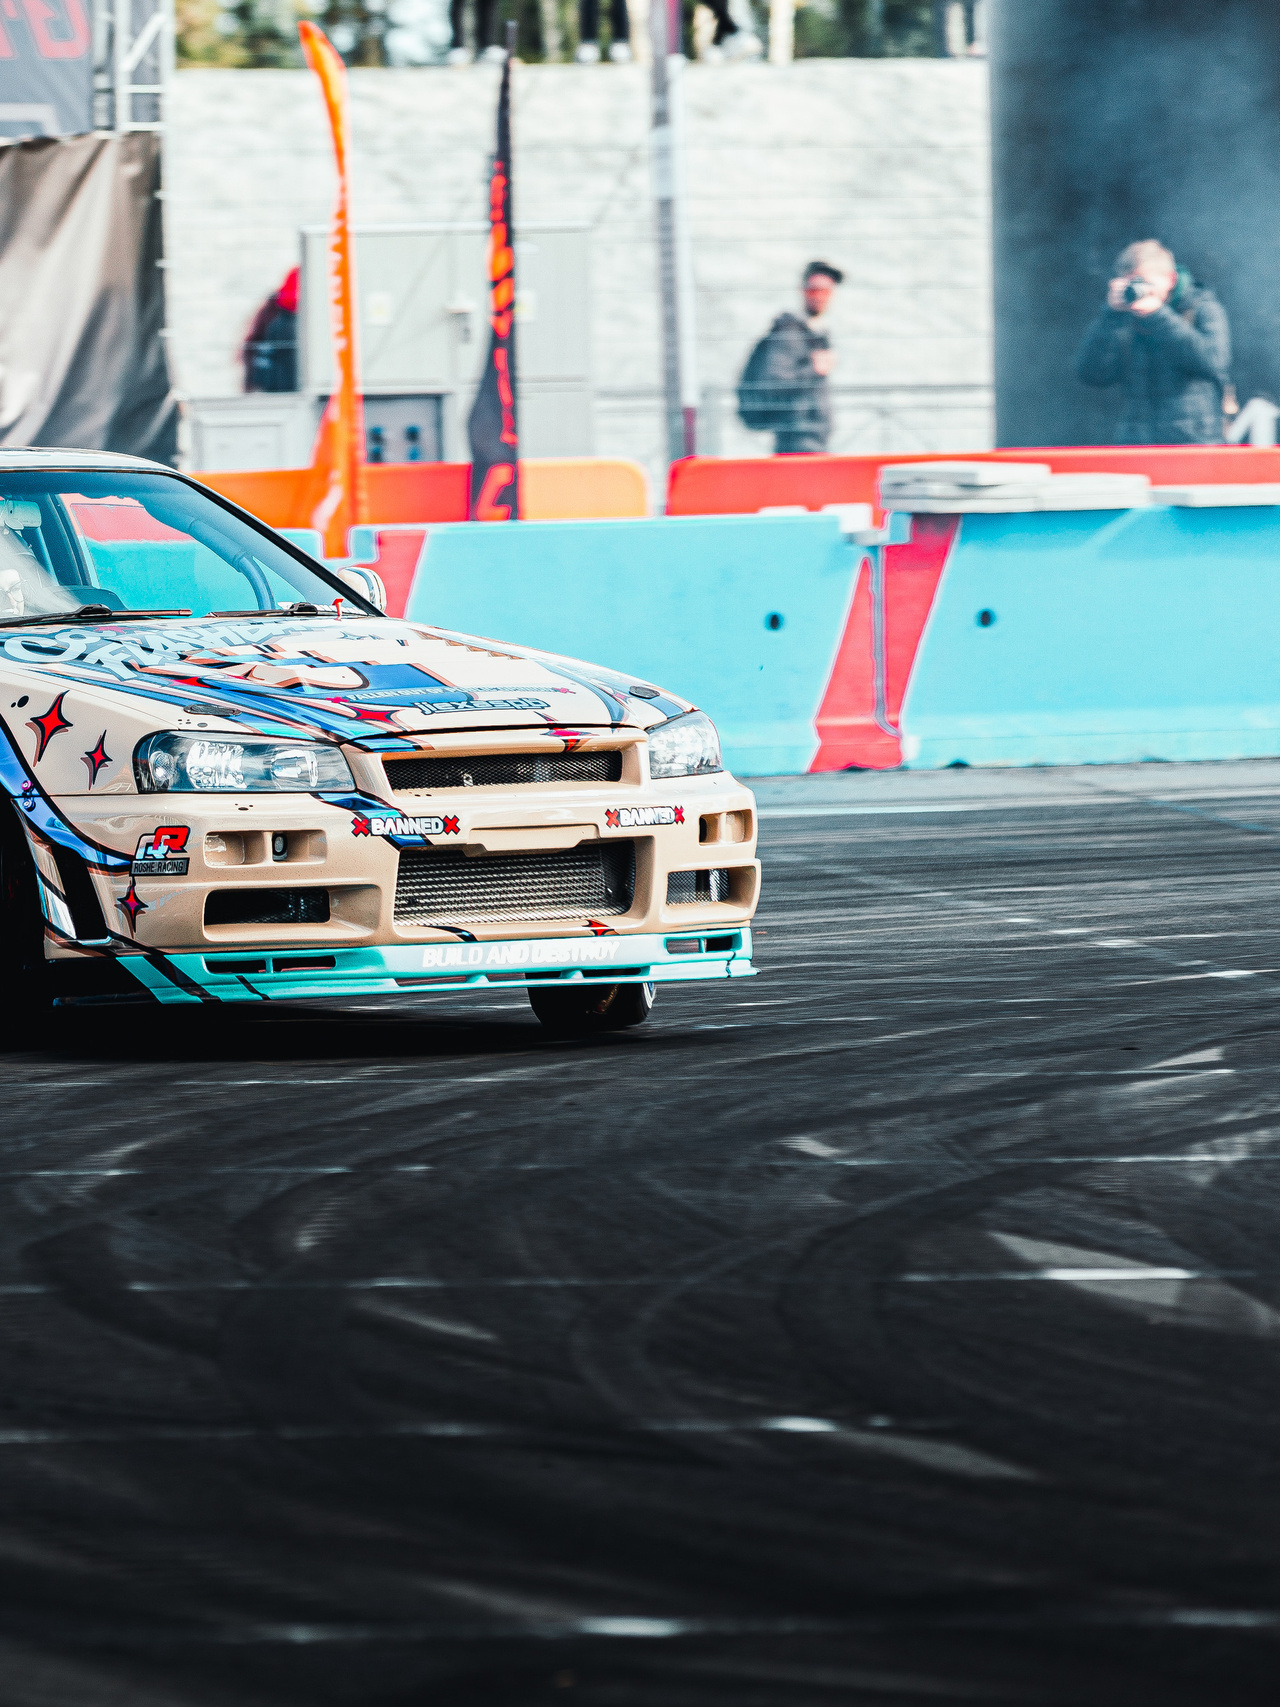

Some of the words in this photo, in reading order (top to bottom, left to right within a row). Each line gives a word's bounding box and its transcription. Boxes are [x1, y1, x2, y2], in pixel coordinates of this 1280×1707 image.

[620, 807, 675, 826] BANNED
[371, 818, 444, 835] BANNED
[134, 862, 155, 872] ROSHE
[157, 862, 183, 872] RACING
[422, 946, 482, 967] BUILD
[486, 944, 529, 964] AND
[531, 941, 620, 963] DESTROY
